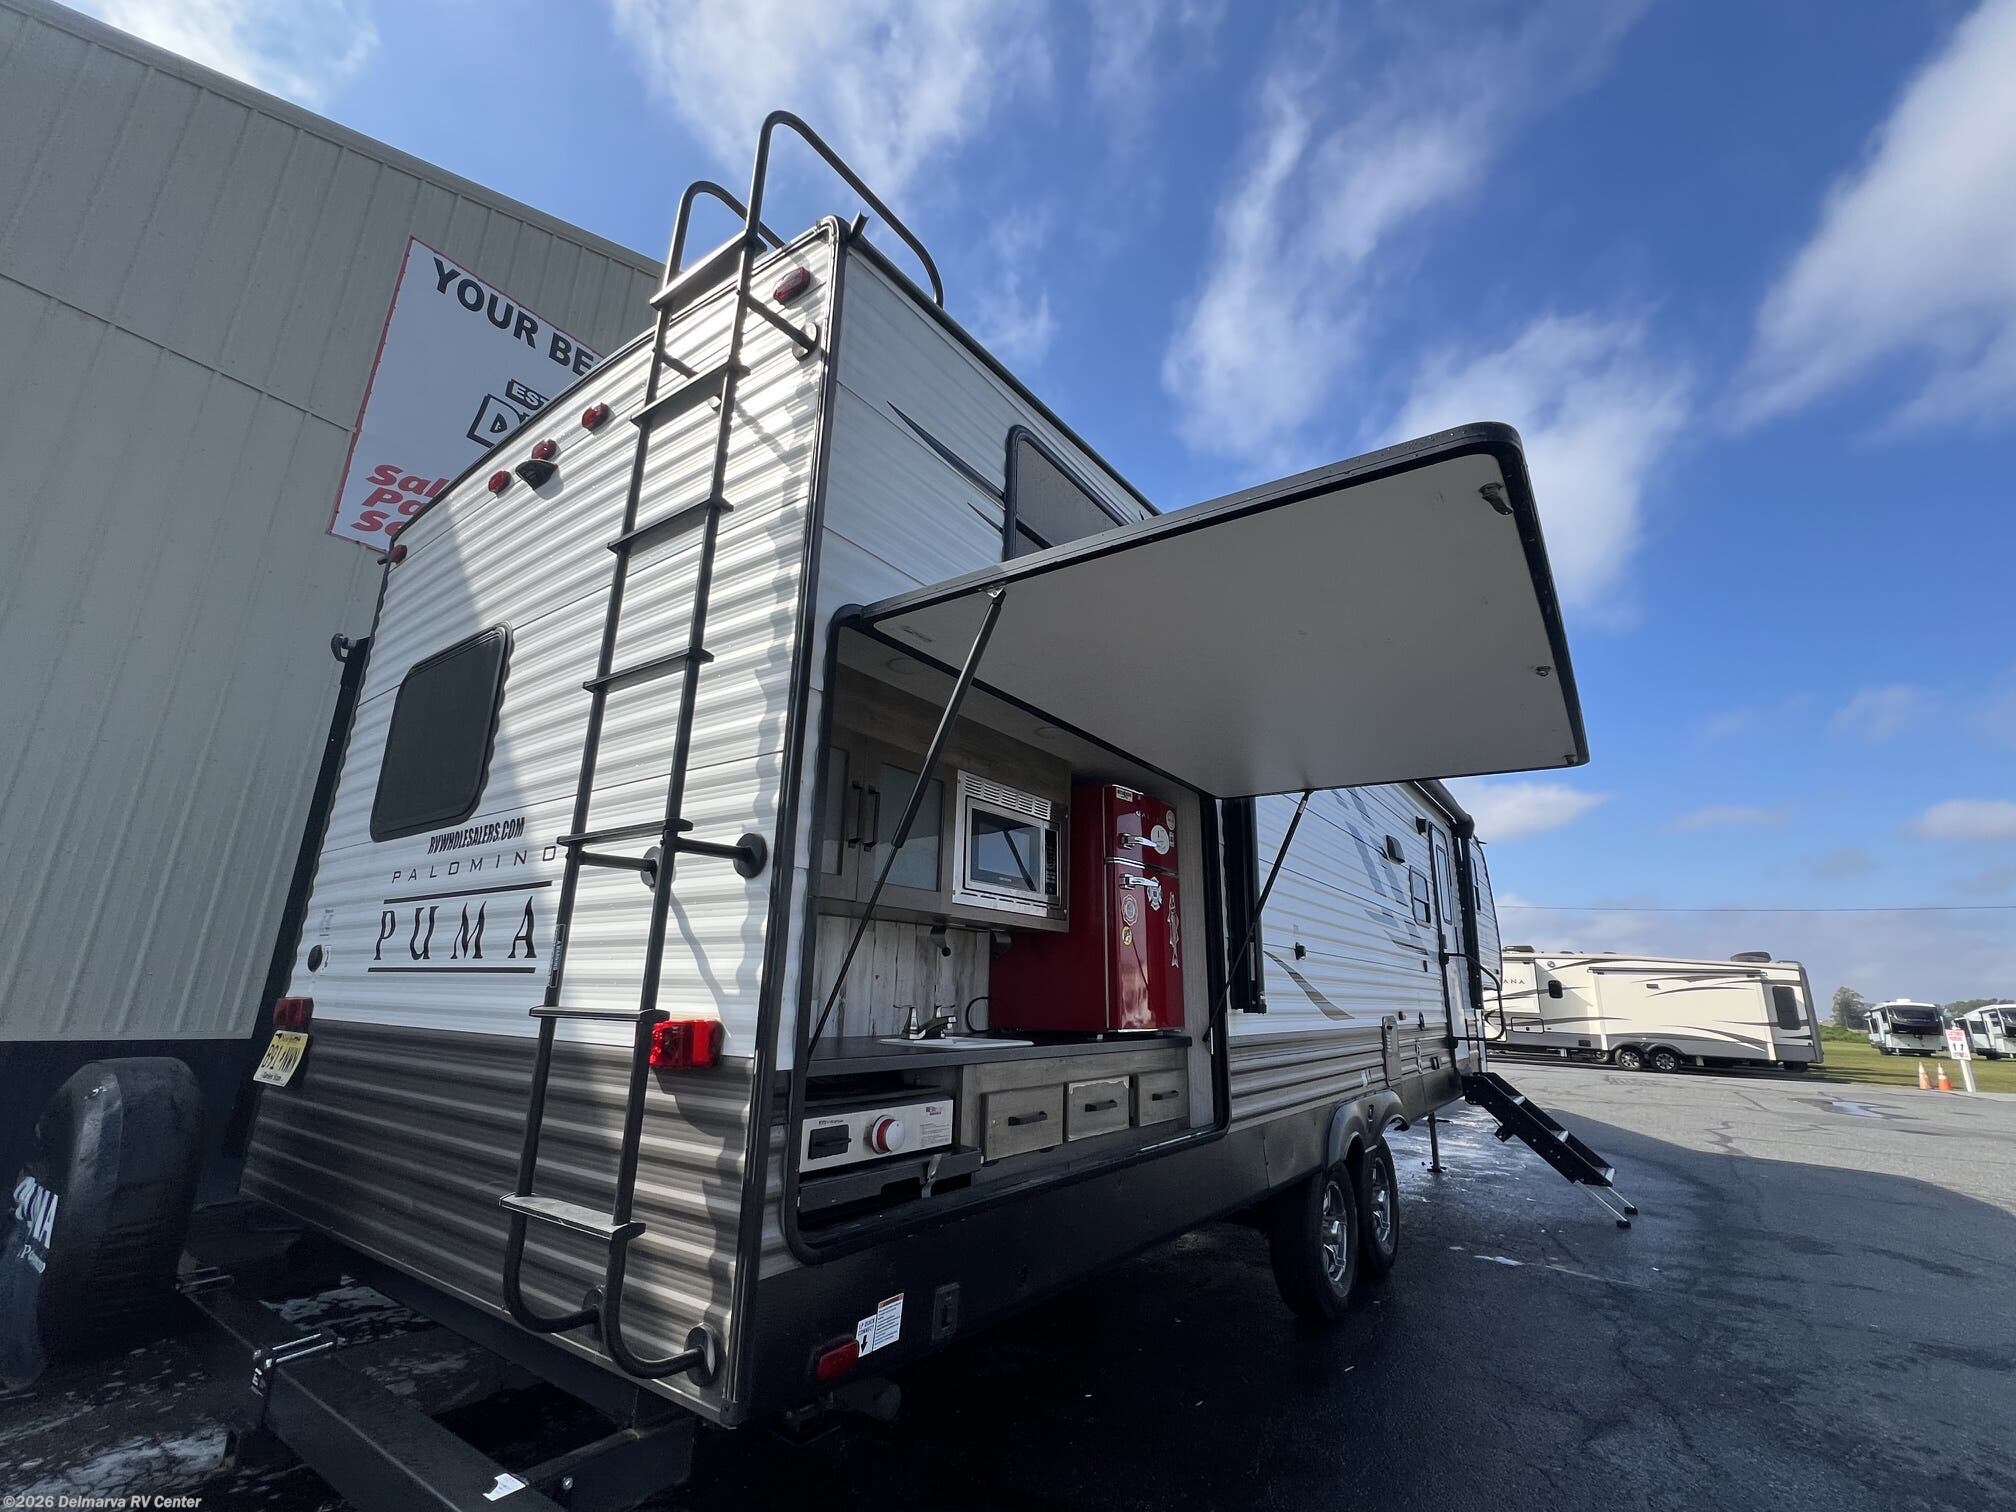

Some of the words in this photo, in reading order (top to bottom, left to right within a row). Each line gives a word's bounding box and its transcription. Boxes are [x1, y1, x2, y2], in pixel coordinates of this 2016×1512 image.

[433, 256, 539, 349] YOUR
[366, 464, 449, 497] Sal
[427, 816, 525, 855] RVWHOLESALERS.COM
[391, 846, 556, 884] PALOMINO
[373, 895, 537, 961] PUMA
